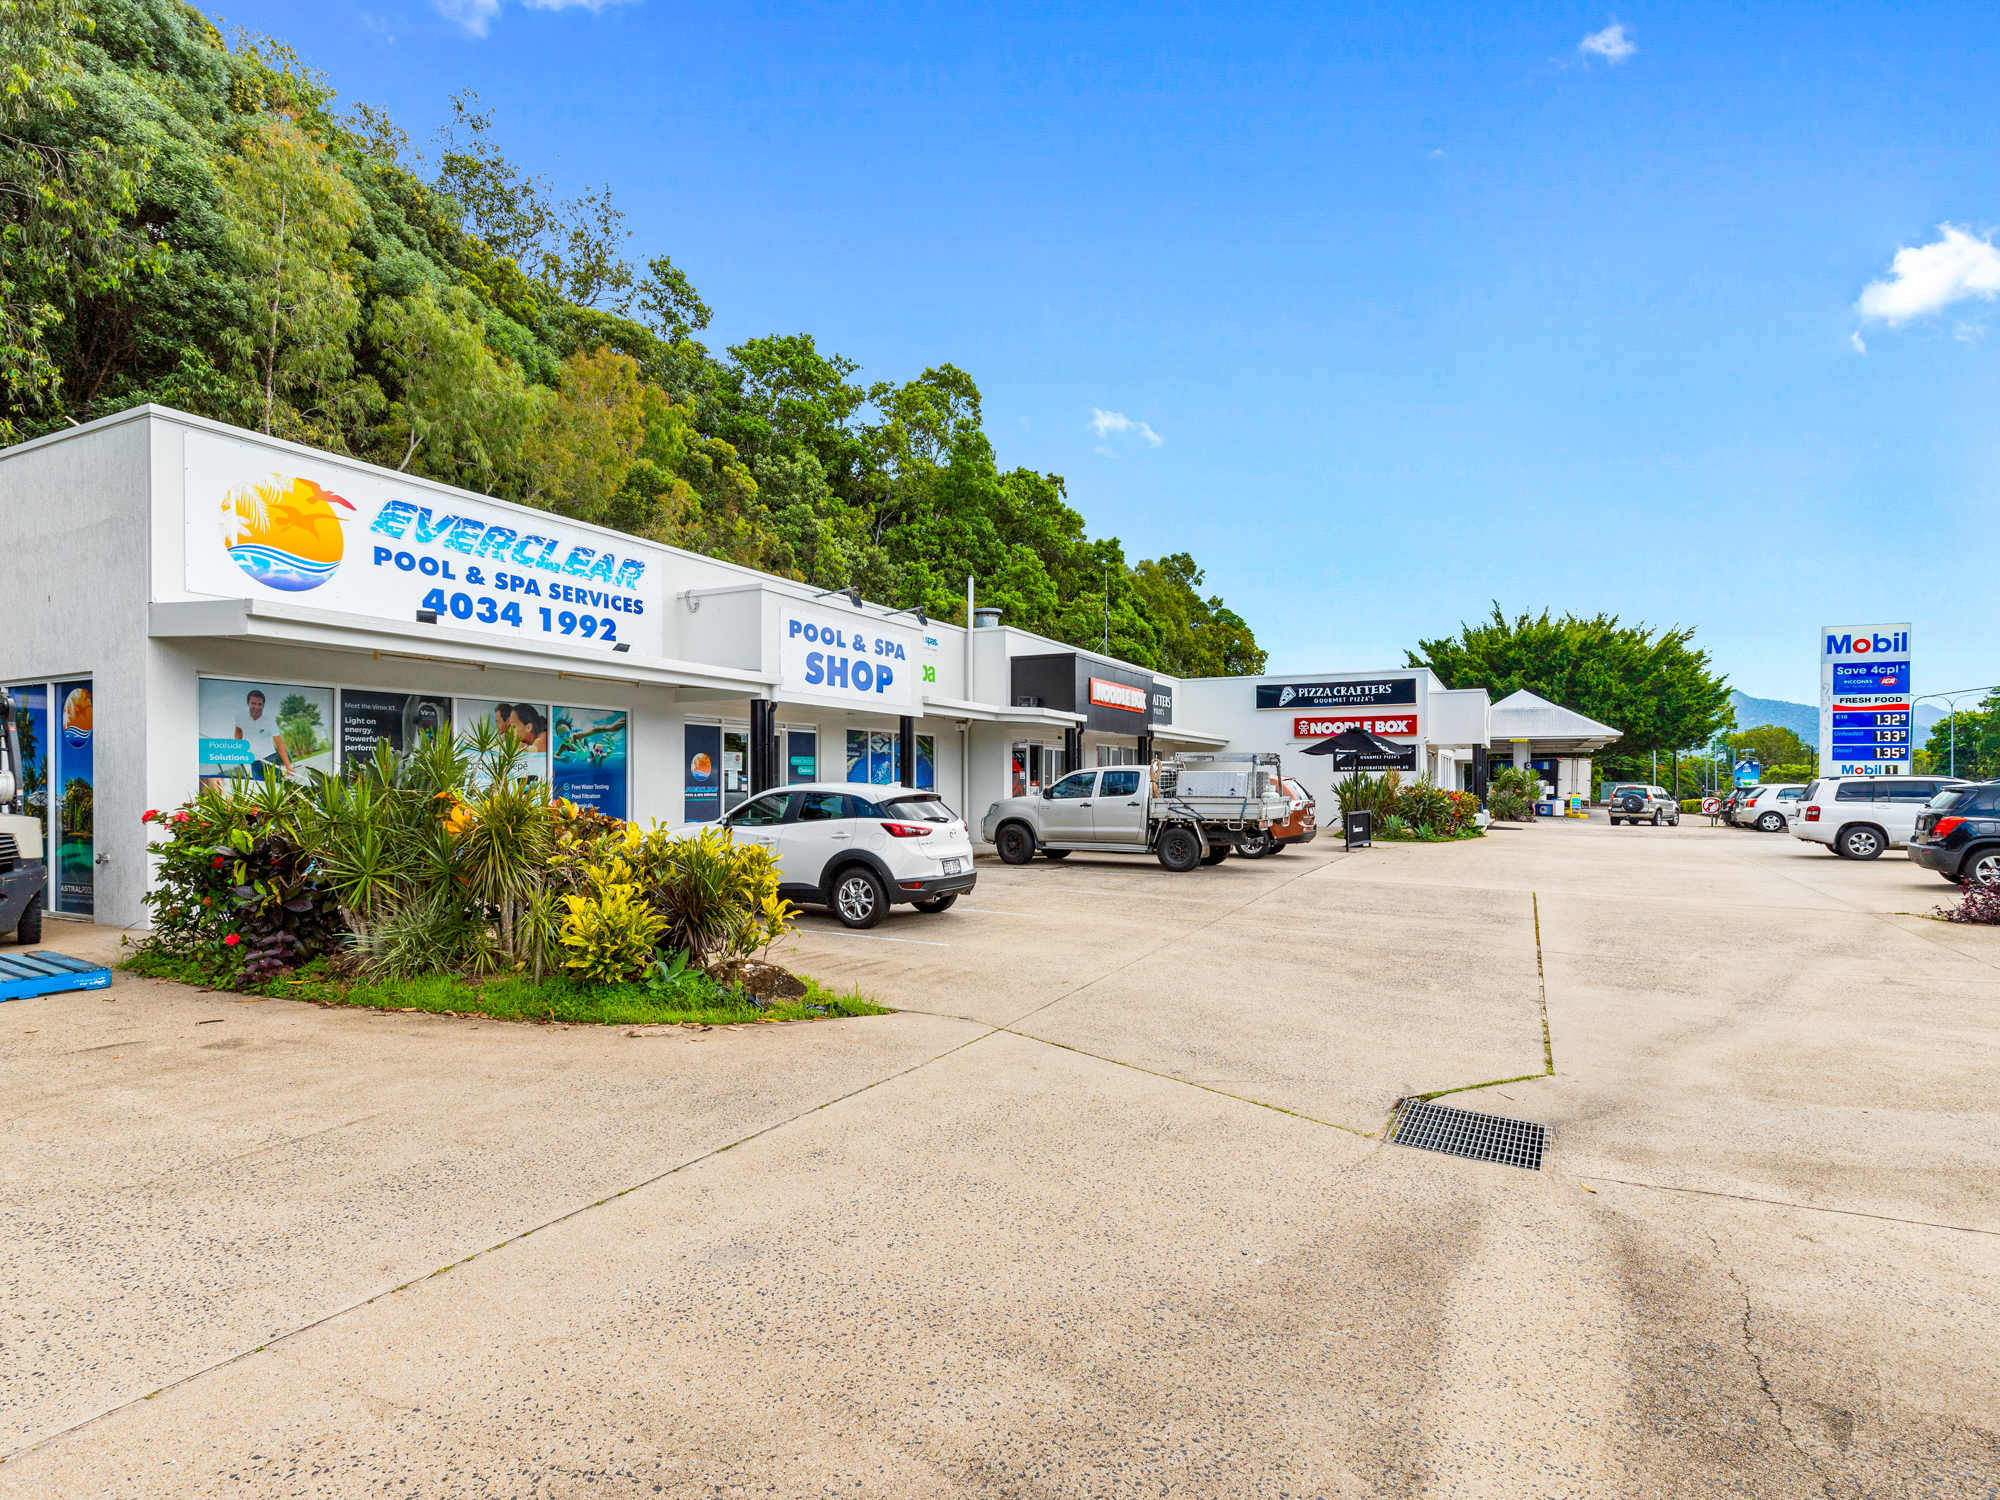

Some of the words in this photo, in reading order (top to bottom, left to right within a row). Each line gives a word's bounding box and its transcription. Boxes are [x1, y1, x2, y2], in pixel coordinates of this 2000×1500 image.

[369, 500, 646, 591] EVERCLEAR
[373, 546, 456, 580] POOL
[465, 566, 486, 586] &
[494, 572, 542, 597] SPA
[548, 582, 645, 615] SERVICES
[421, 588, 523, 628] 4034
[538, 606, 617, 642] 1992
[788, 619, 847, 649] POOL
[852, 634, 867, 653] &
[874, 638, 906, 661] SPA
[1826, 631, 1908, 655] Mobil
[804, 651, 894, 694] SHOP
[1836, 666, 1867, 675] Save
[1092, 682, 1130, 707] NOODLE
[1131, 690, 1147, 710] BOX
[1298, 687, 1333, 698] PIZZA
[1333, 683, 1392, 697] CRAFTERS
[1152, 693, 1172, 709] AFTERS
[1313, 696, 1346, 704] GOURMET
[1349, 695, 1375, 703] PIZZA'S
[344, 717, 365, 726] Light
[344, 727, 374, 735] energy.
[209, 741, 243, 750] Poolside
[344, 744, 396, 752] performe.
[209, 753, 250, 762] Solutions
[1841, 764, 1882, 775] Mobil
